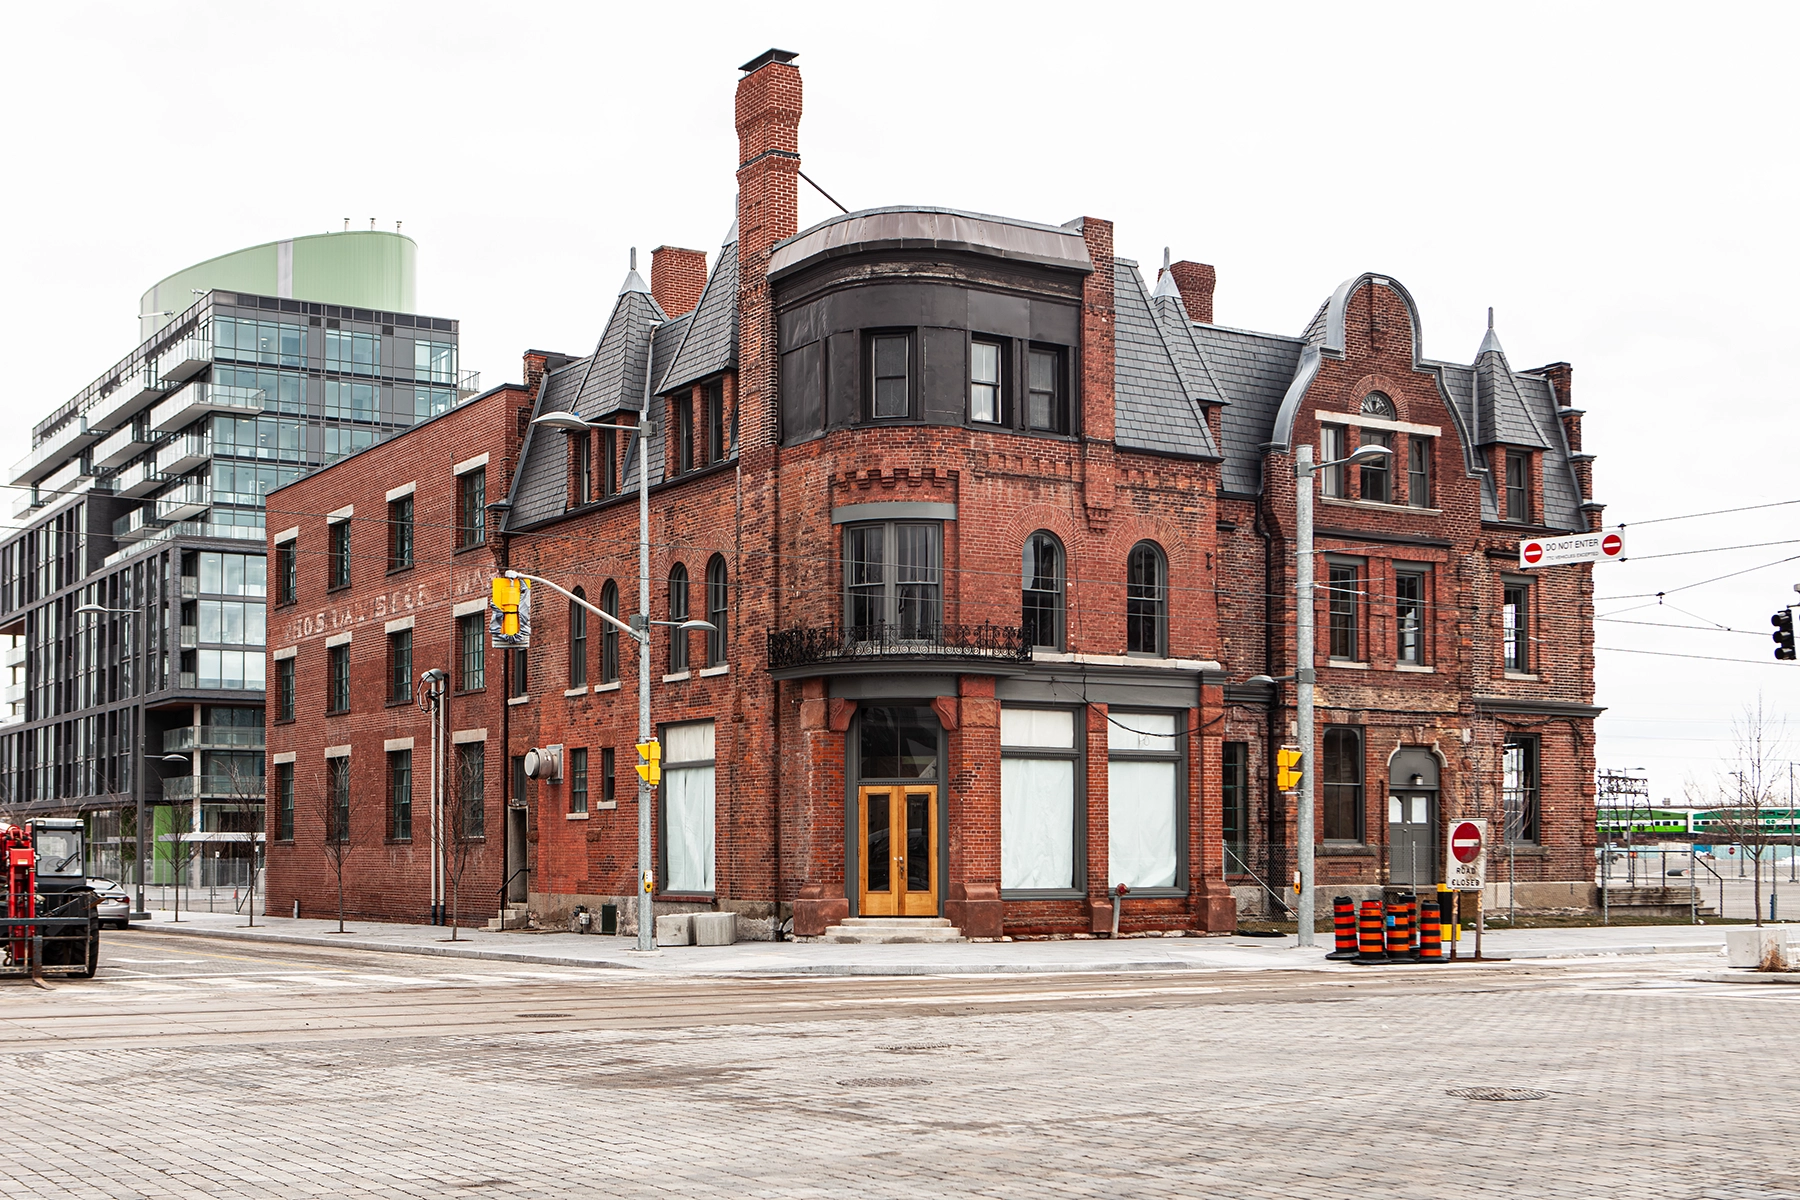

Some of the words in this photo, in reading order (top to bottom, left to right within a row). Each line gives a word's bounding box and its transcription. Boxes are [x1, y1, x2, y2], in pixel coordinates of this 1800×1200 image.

[1546, 543, 1556, 551] DO
[1558, 541, 1573, 550] NOT
[1575, 538, 1598, 548] ENTER
